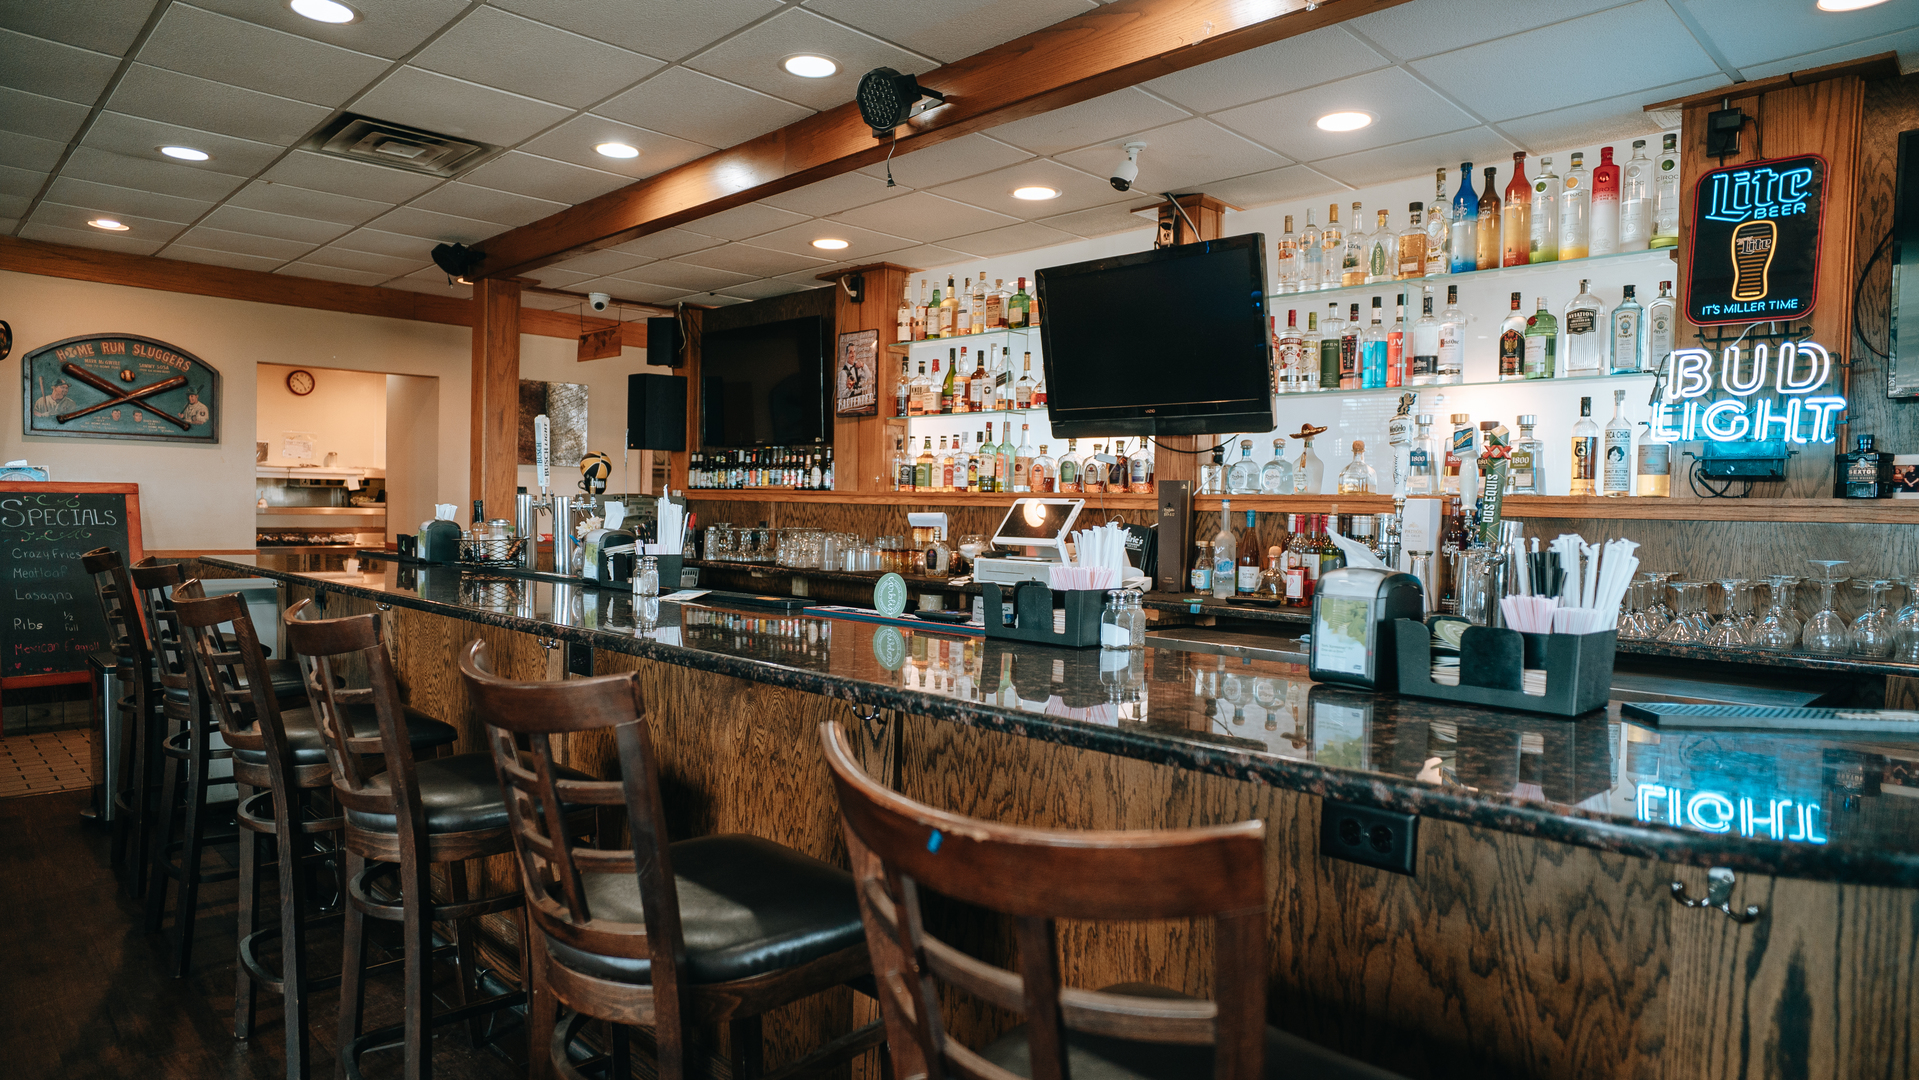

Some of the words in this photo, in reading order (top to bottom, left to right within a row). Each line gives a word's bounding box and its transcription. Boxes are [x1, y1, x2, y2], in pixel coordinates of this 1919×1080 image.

[1705, 167, 1812, 222] Lite
[1754, 202, 1806, 219] BEER
[1741, 239, 1771, 254] Lite
[1568, 311, 1594, 319] AVIATION
[1702, 303, 1721, 315] IT'S
[1723, 302, 1765, 314] MILLER
[1769, 298, 1798, 310] TIME
[101, 341, 125, 355] RUN
[132, 343, 192, 372] SLUGGERS
[1668, 341, 1830, 399] BUD
[1650, 395, 1847, 444] LIGHT
[1512, 456, 1529, 464] 1800
[1485, 473, 1498, 502] EQUIS
[1, 499, 117, 528] SPECIALS
[1482, 504, 1495, 523] DOS
[13, 565, 68, 579] Meatloaf
[15, 589, 73, 604] Lasagna
[13, 618, 44, 630] Ribs
[15, 642, 59, 655] Mexican
